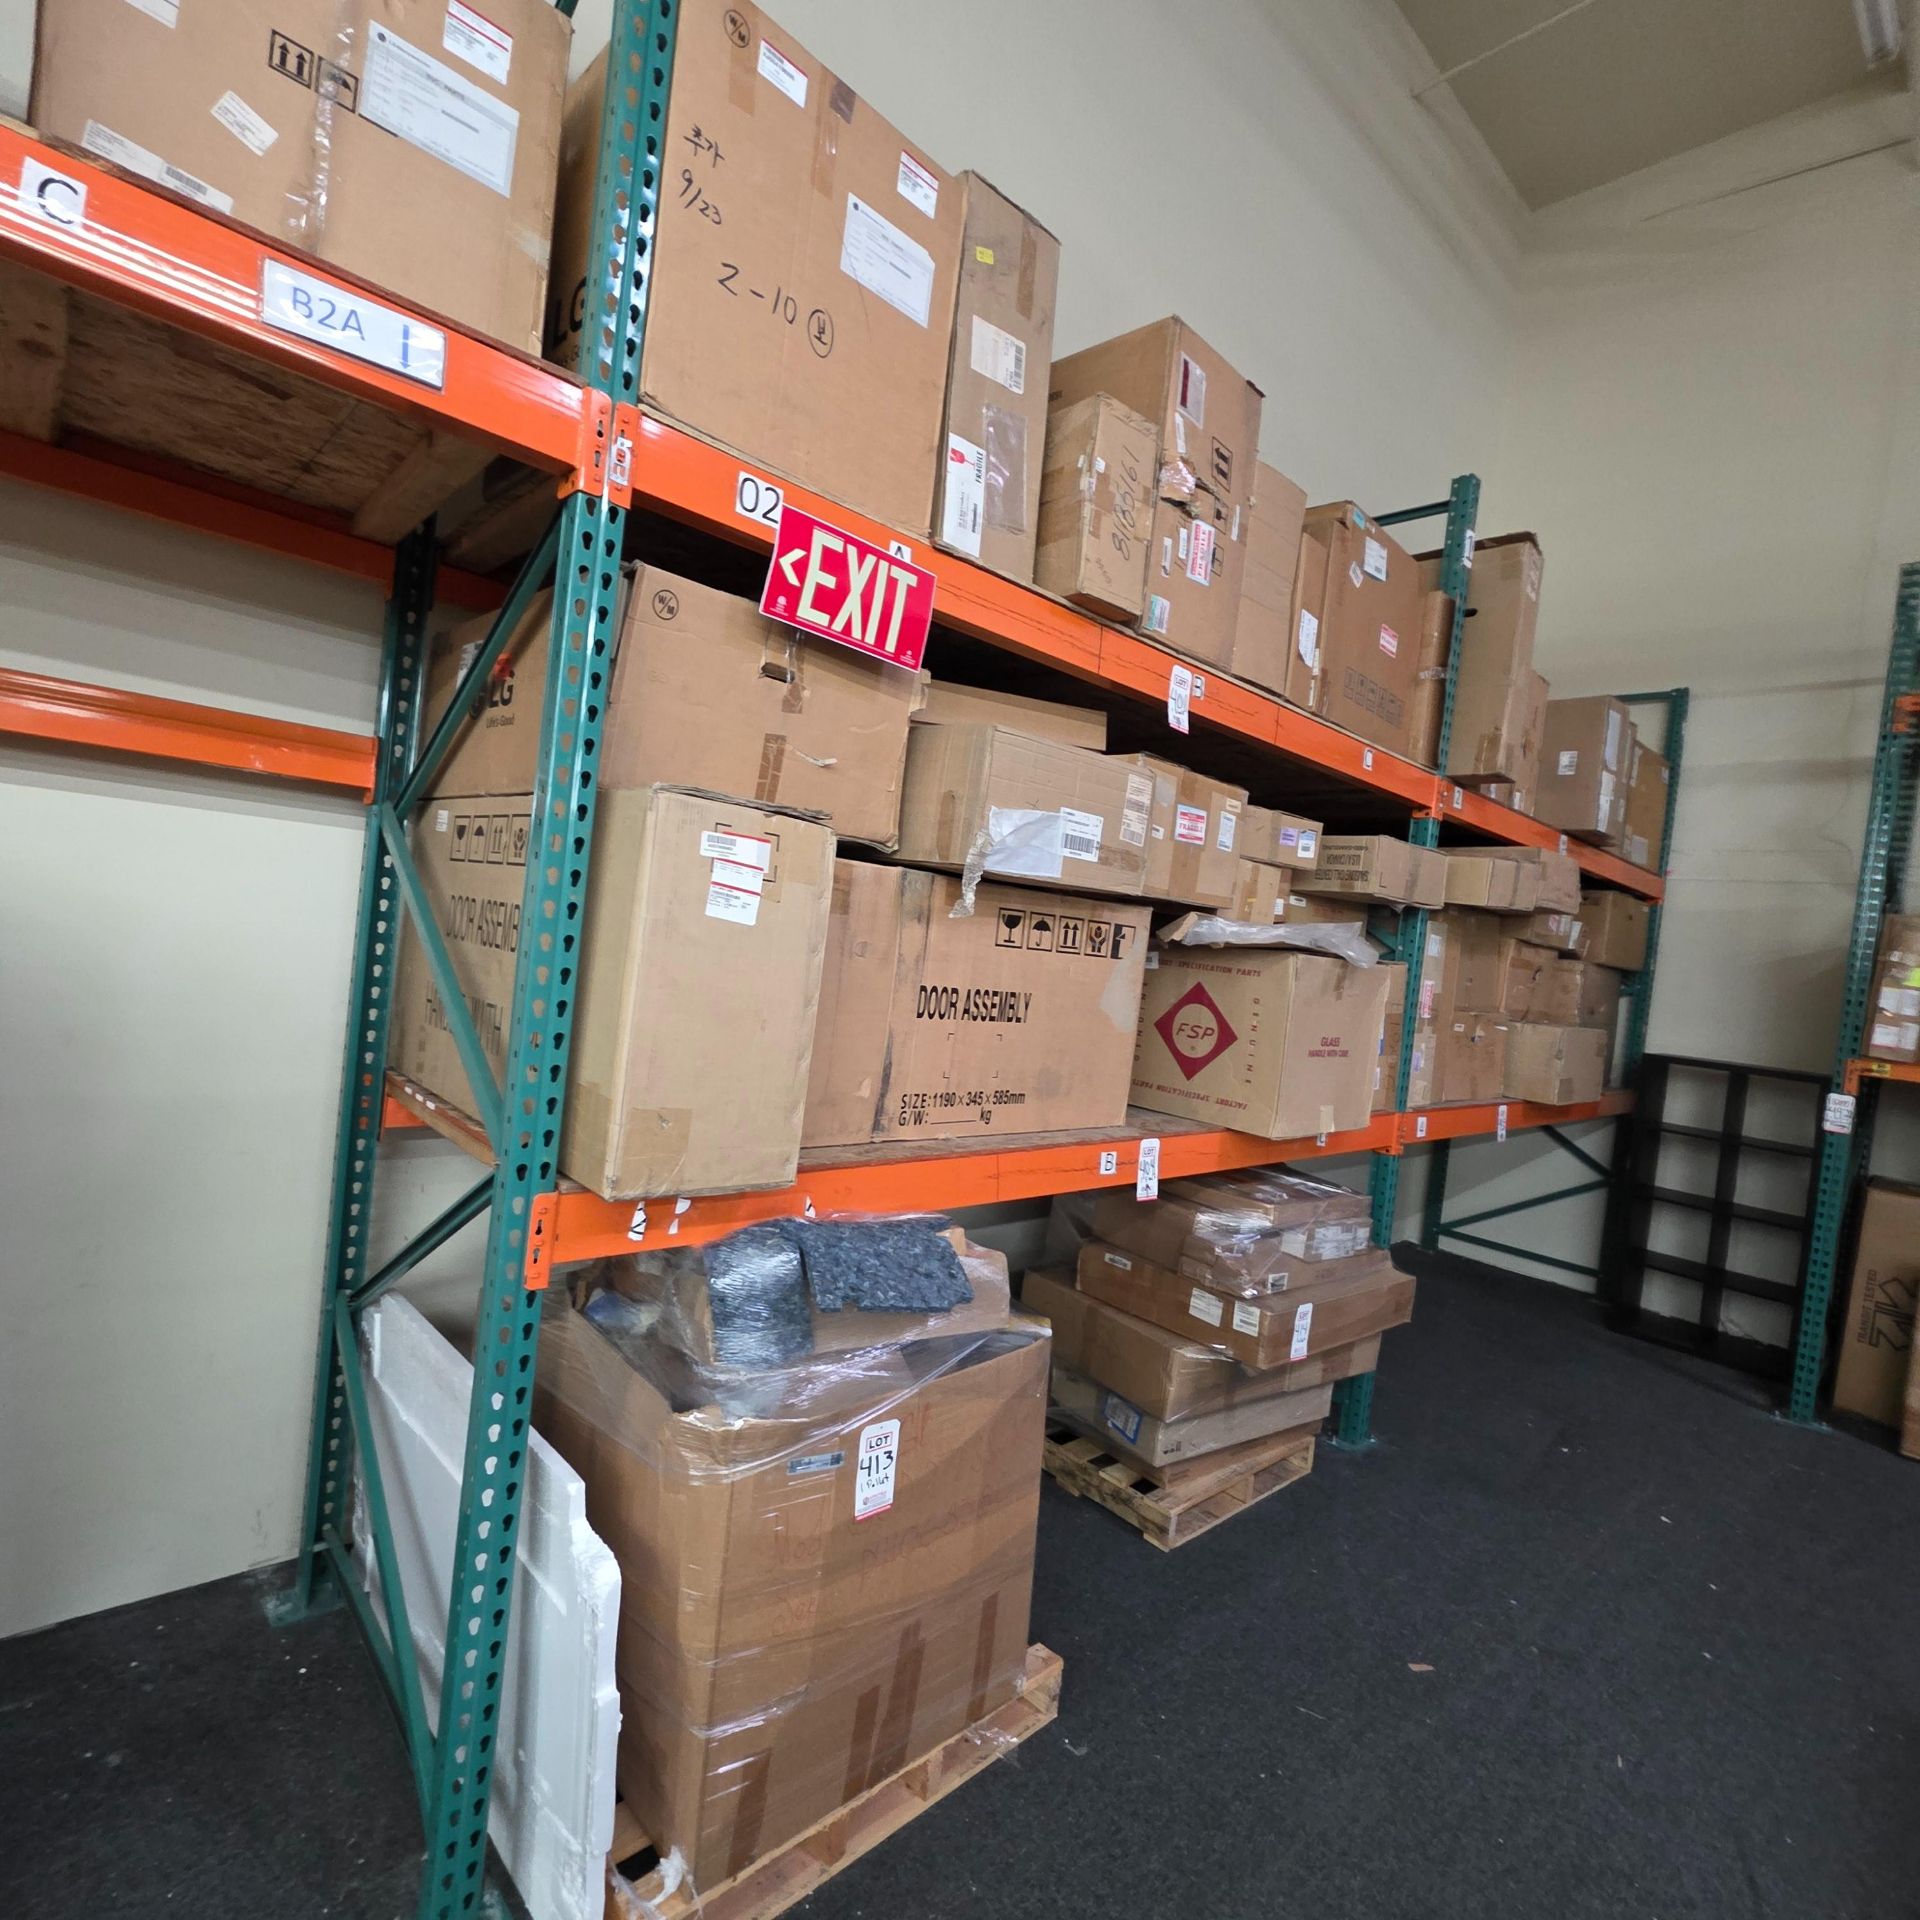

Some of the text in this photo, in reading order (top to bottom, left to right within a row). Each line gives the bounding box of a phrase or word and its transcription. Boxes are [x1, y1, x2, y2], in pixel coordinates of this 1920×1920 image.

[37, 177, 79, 225] C
[291, 286, 366, 342] B2A
[974, 449, 985, 484] FRAGILE
[739, 476, 781, 525] 02
[796, 526, 919, 654] EXIT
[477, 898, 520, 953] ASSEMB
[1235, 967, 1262, 977] PARTS
[916, 984, 1033, 1024] DOOR ASSEMBLY
[1175, 1022, 1216, 1041] FSP
[979, 1106, 992, 1125] kg
[1104, 1152, 1115, 1172] B
[868, 1435, 890, 1450] LOT
[859, 1450, 894, 1478] 413
